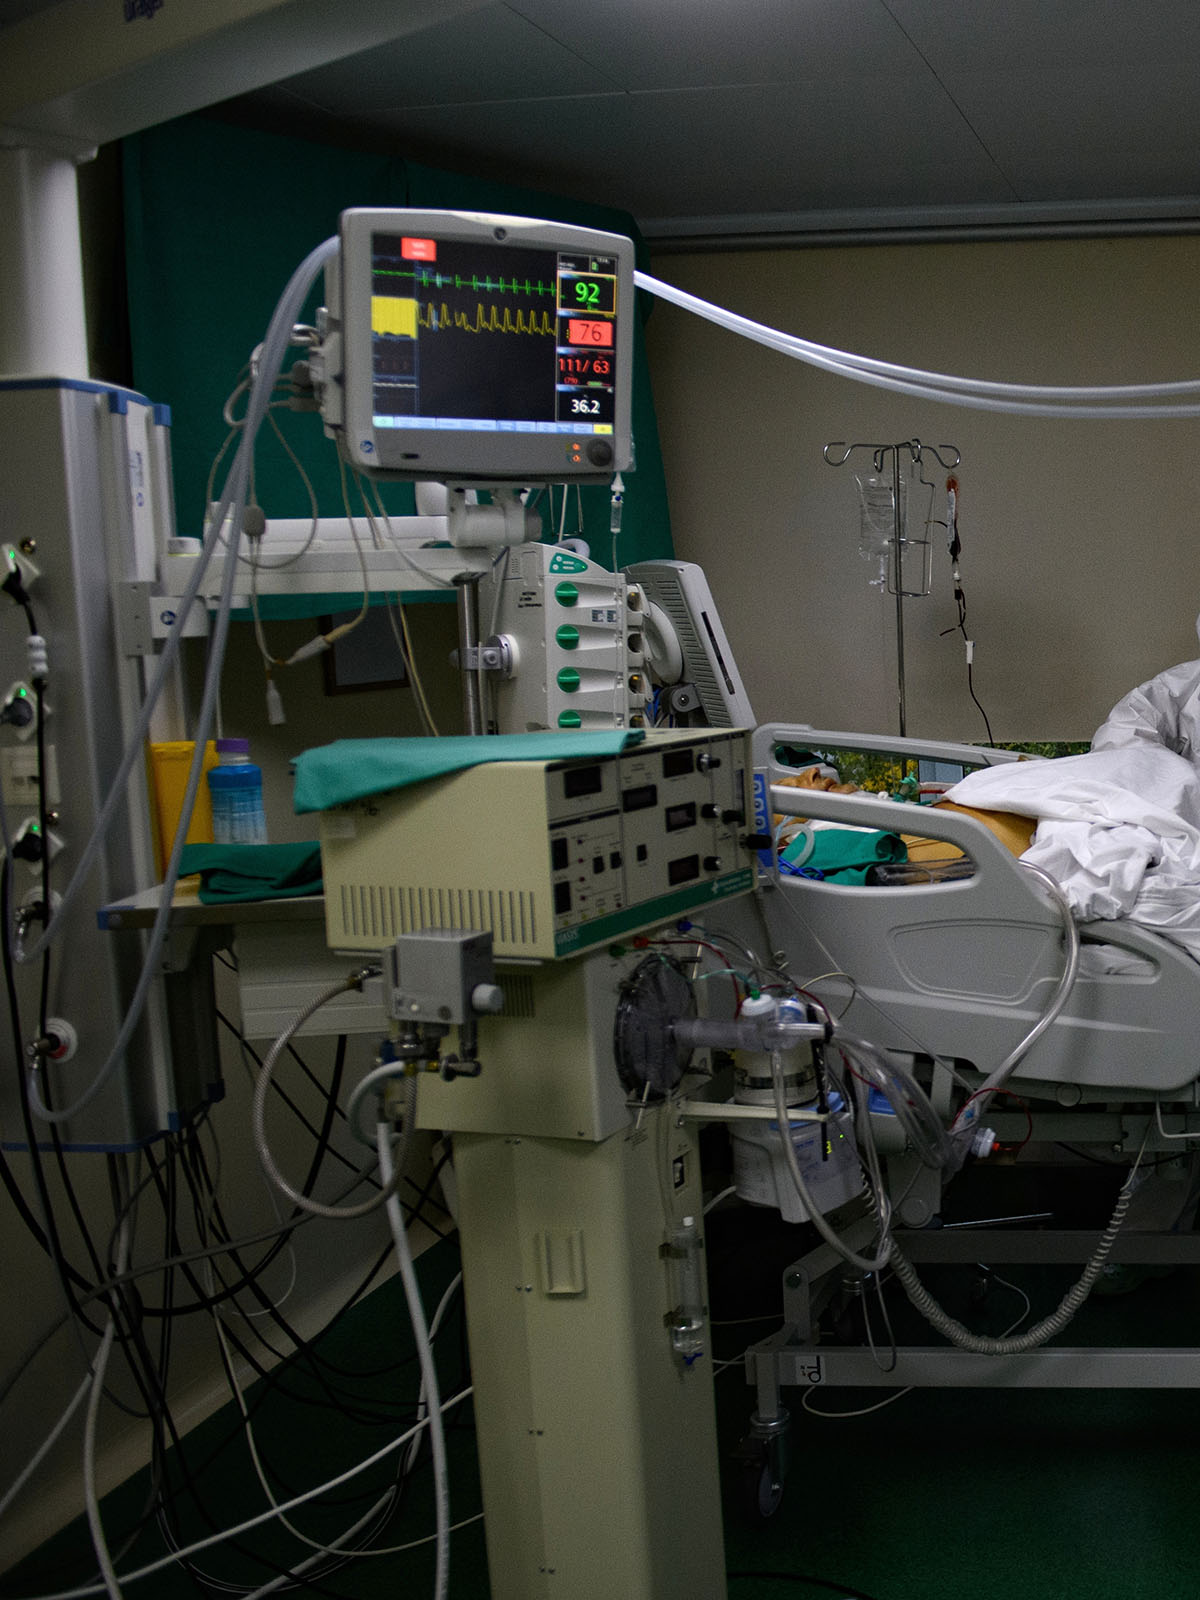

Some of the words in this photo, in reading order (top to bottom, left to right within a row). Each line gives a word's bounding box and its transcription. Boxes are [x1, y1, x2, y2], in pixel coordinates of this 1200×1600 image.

[575, 282, 601, 304] 92
[579, 323, 602, 342] 76
[592, 360, 611, 374] 63
[571, 399, 601, 414] 36.2
